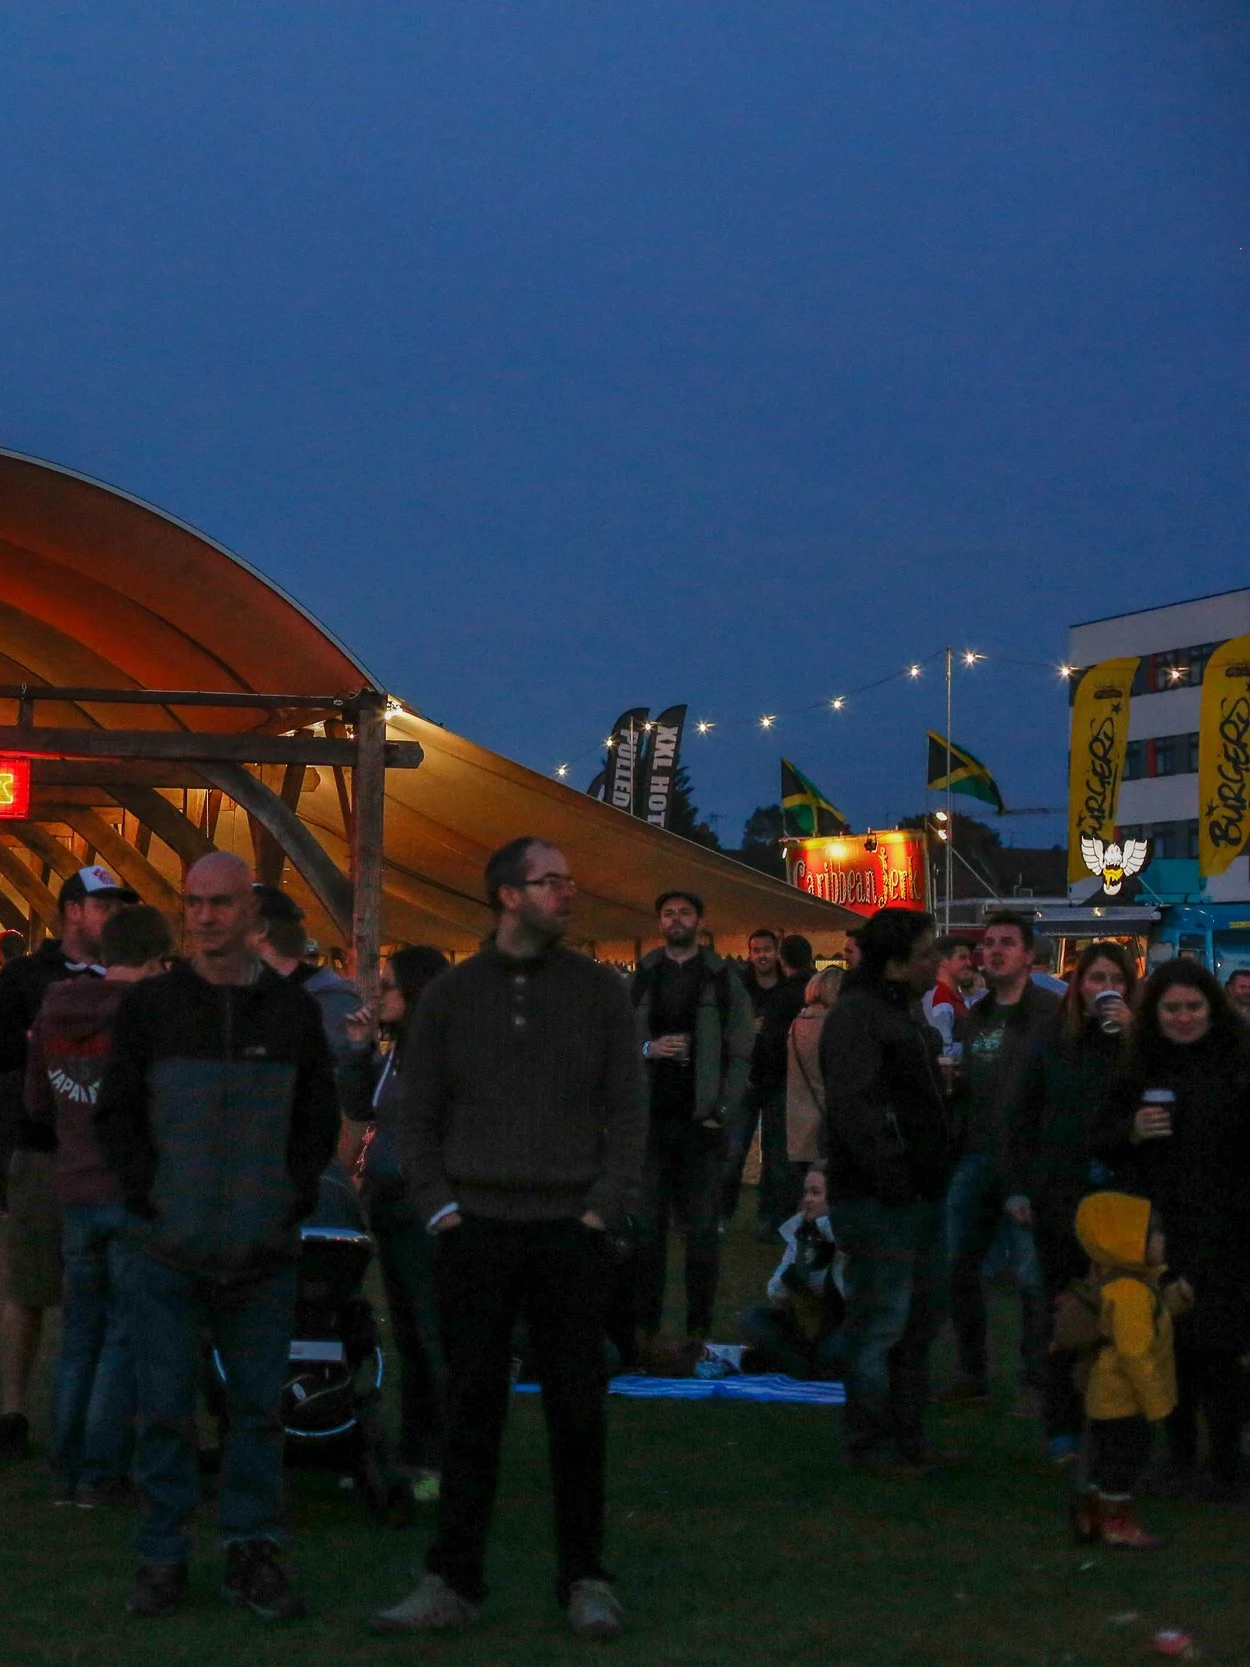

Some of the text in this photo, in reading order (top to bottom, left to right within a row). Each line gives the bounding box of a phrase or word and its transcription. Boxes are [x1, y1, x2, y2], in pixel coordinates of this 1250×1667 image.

[612, 728, 639, 808] PULLED
[647, 725, 679, 828] XXL HOT
[792, 846, 923, 909] Caribbean Jerk
